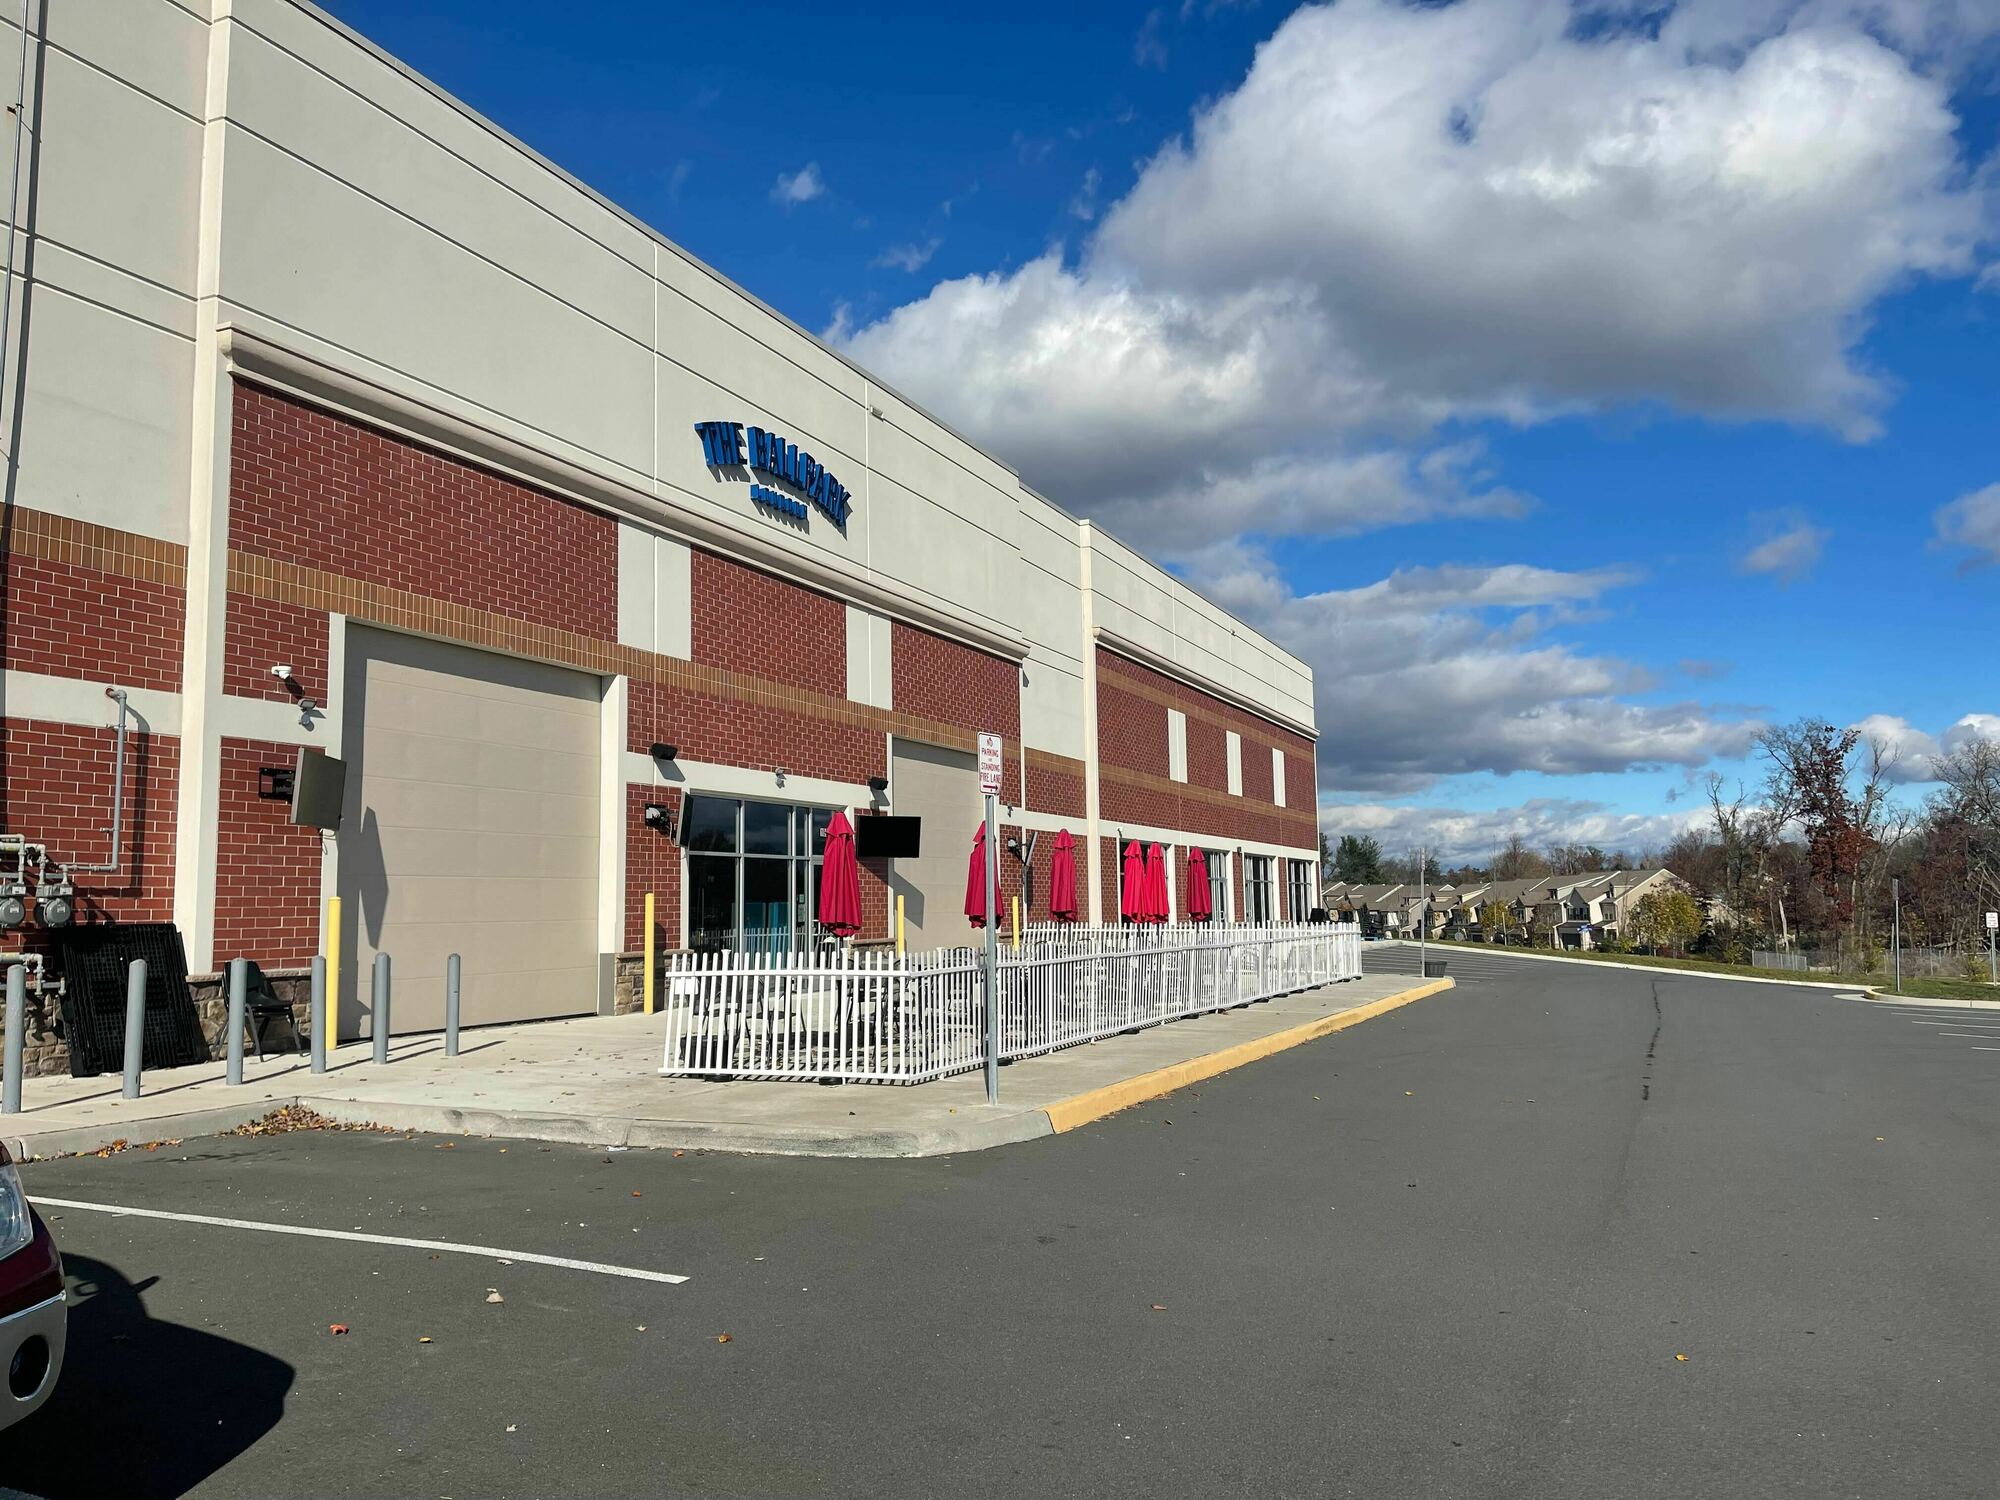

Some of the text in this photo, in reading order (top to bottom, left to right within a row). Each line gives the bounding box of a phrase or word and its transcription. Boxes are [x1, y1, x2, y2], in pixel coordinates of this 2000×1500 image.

[694, 422, 748, 465] THE
[747, 426, 852, 527] BALLPARK
[981, 747, 999, 758] PARKING
[981, 762, 1000, 772] STANDING
[980, 772, 1001, 784] FIRE LANE
